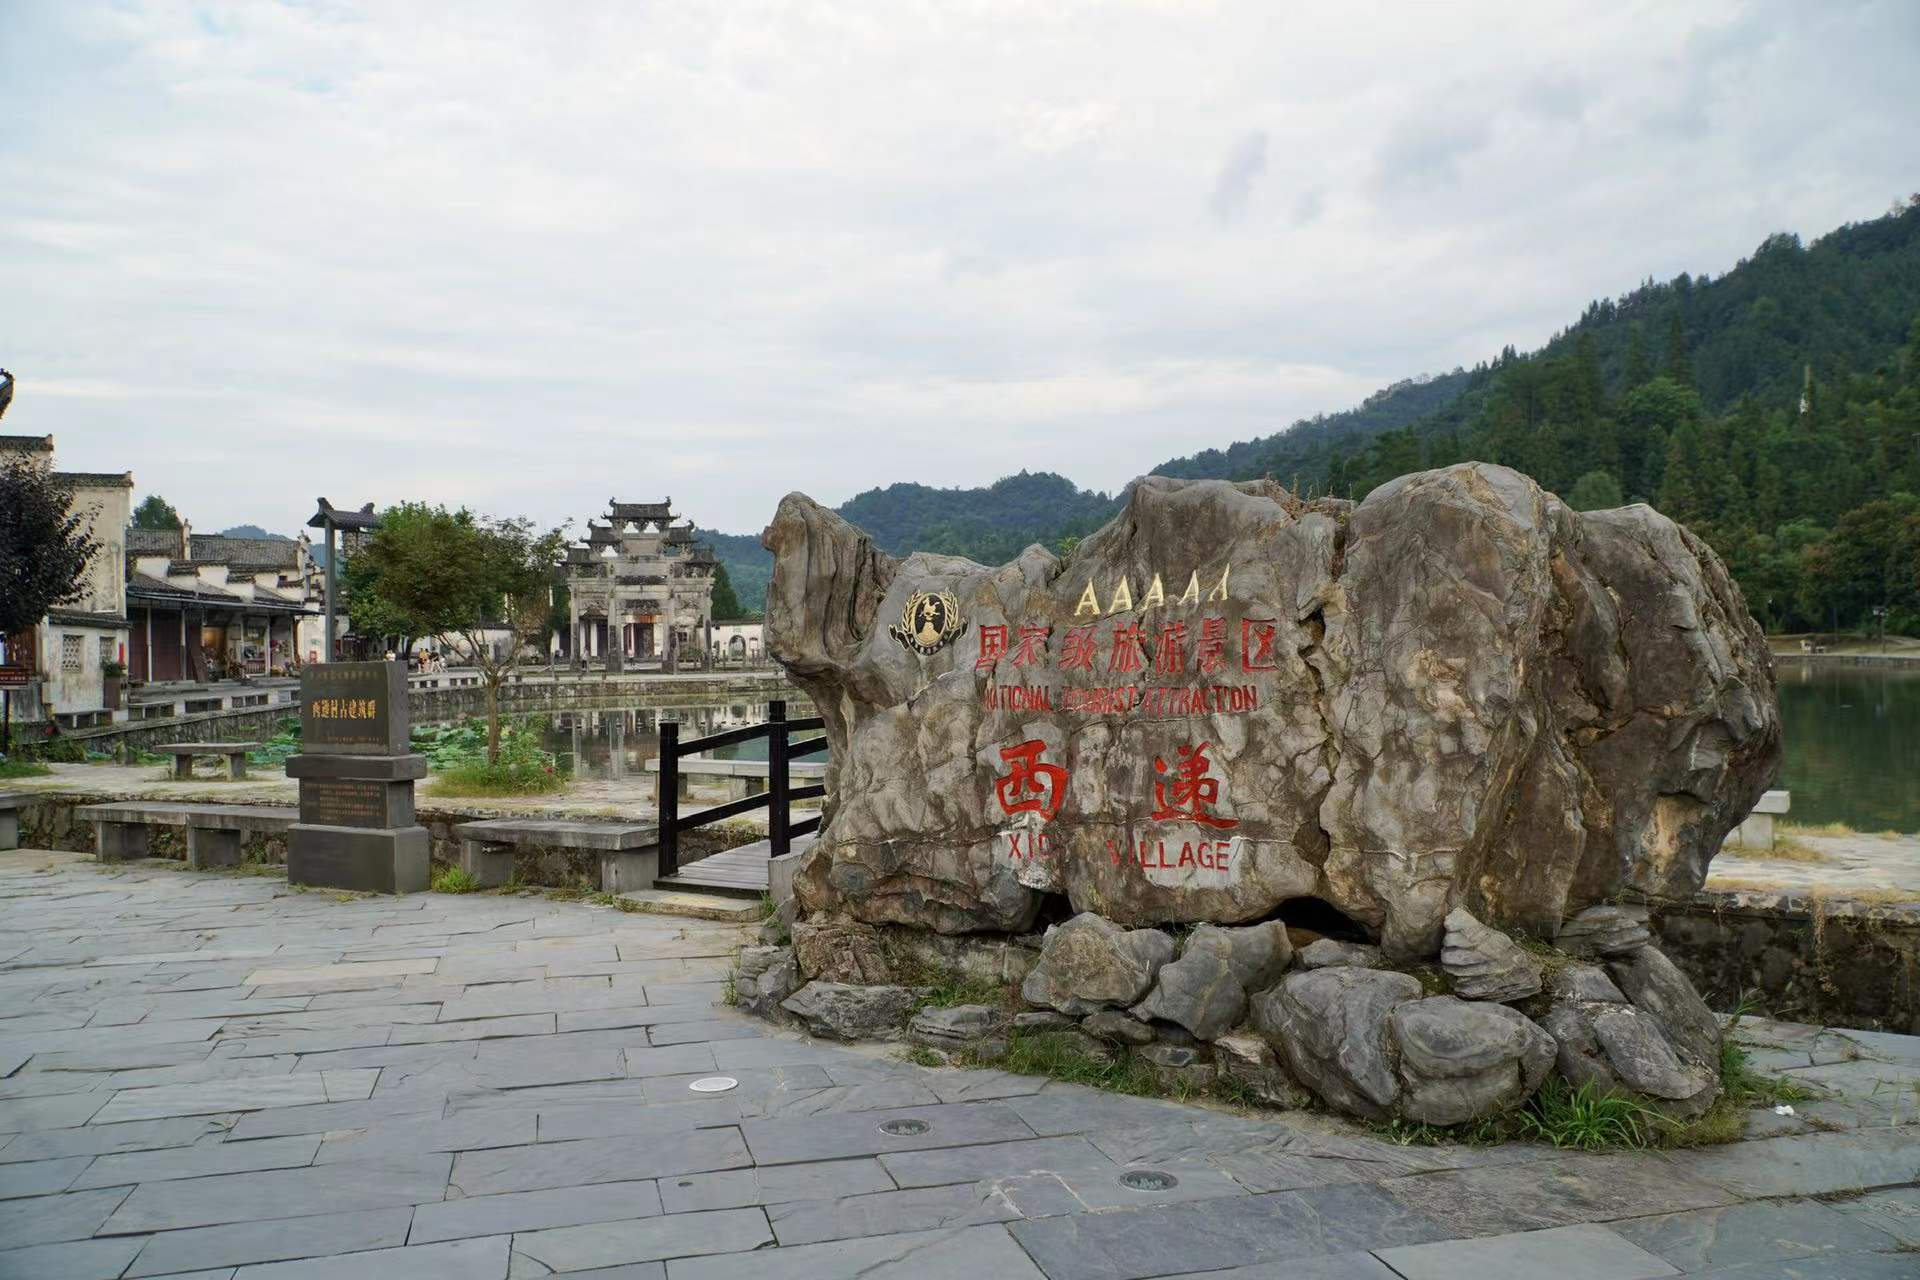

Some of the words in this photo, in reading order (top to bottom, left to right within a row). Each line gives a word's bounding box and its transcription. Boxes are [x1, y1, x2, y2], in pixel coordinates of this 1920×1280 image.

[975, 618, 1279, 674] 国家级旅游景区
[983, 684, 1052, 713] NATIONAL
[1062, 685, 1137, 714] TOURIST
[1145, 684, 1259, 718] ATTRACTION
[995, 739, 1241, 830] 西递
[1106, 840, 1231, 872] VILLAGE
